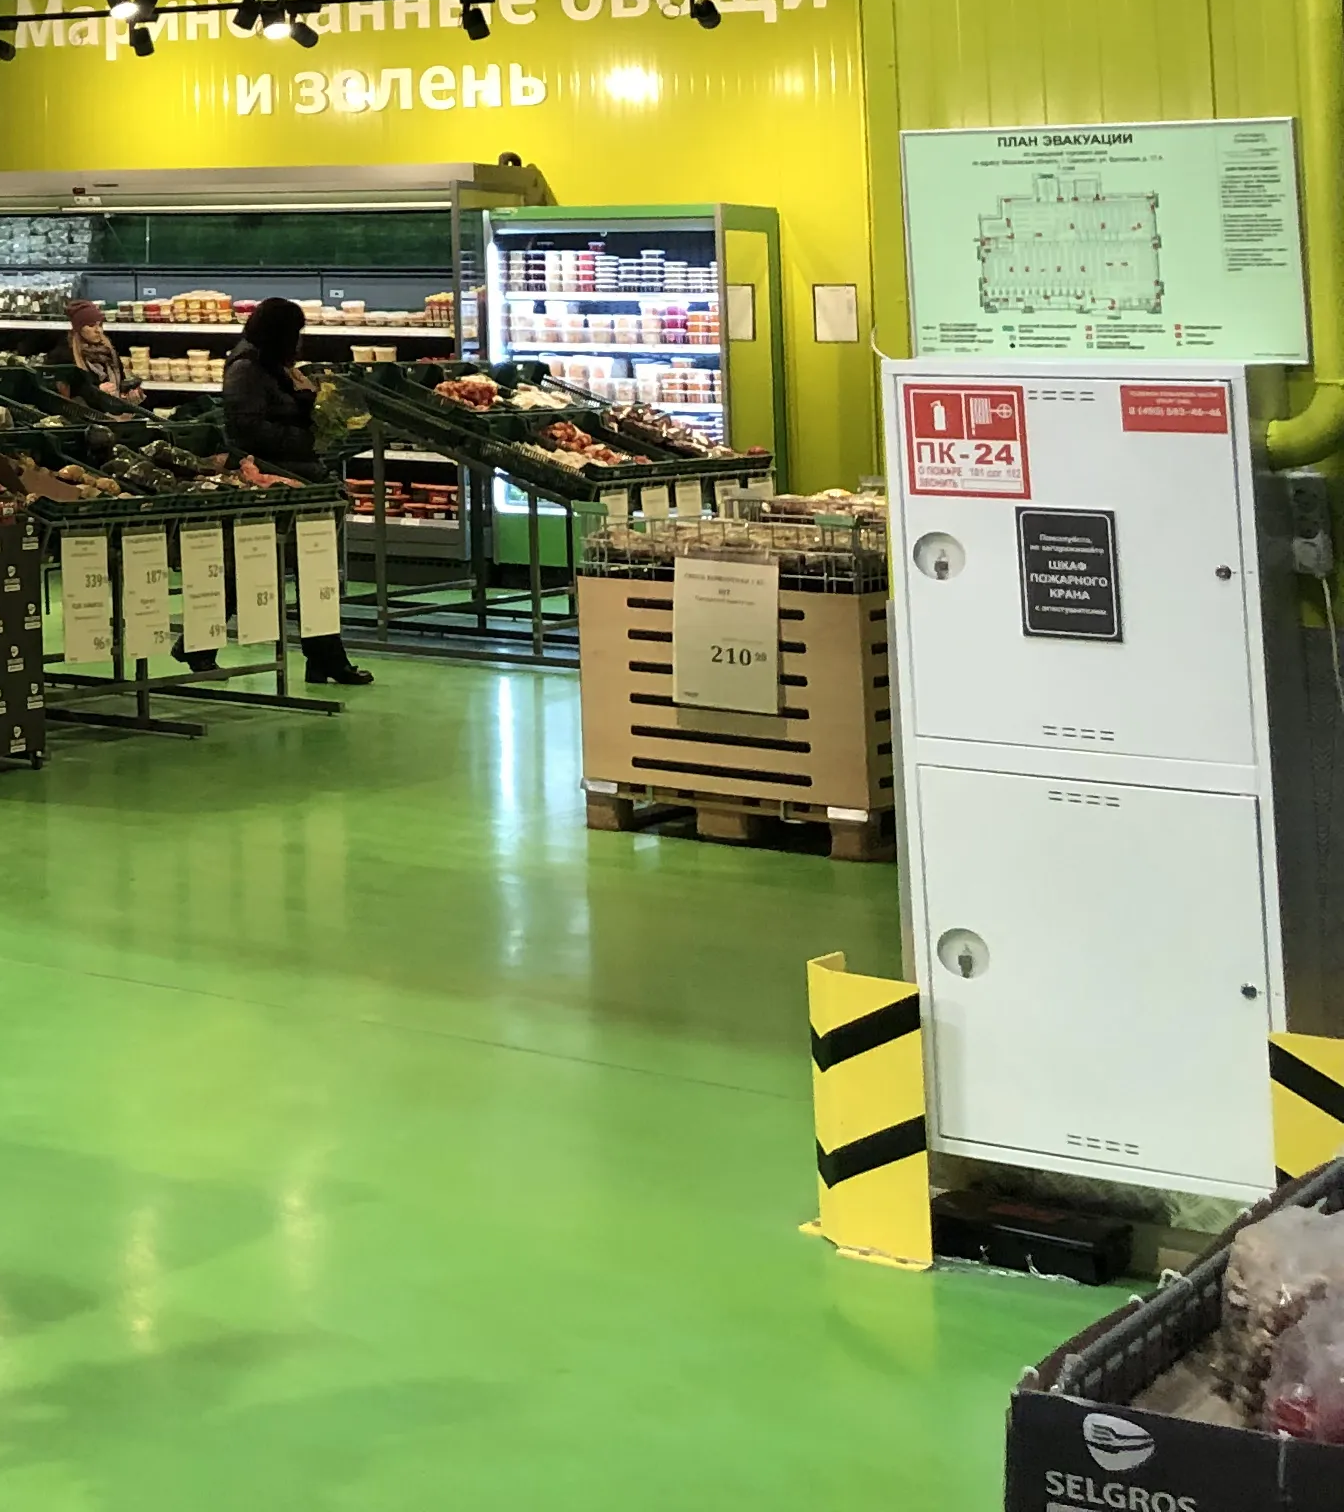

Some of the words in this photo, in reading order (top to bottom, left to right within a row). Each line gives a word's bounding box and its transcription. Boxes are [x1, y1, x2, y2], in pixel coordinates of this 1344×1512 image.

[236, 74, 275, 116] и
[294, 62, 547, 116] зелень
[997, 136, 1038, 147] ПЛАН
[1042, 133, 1133, 146] ЭВАКУАЦИИ
[916, 442, 1015, 465] ПК-24
[1048, 560, 1087, 571] ШКАФ
[1030, 573, 1108, 587] ПОЖАРНОГО
[1049, 588, 1091, 600] КРАНА
[711, 645, 752, 666] 210
[1045, 1469, 1198, 1512] SELGROS
